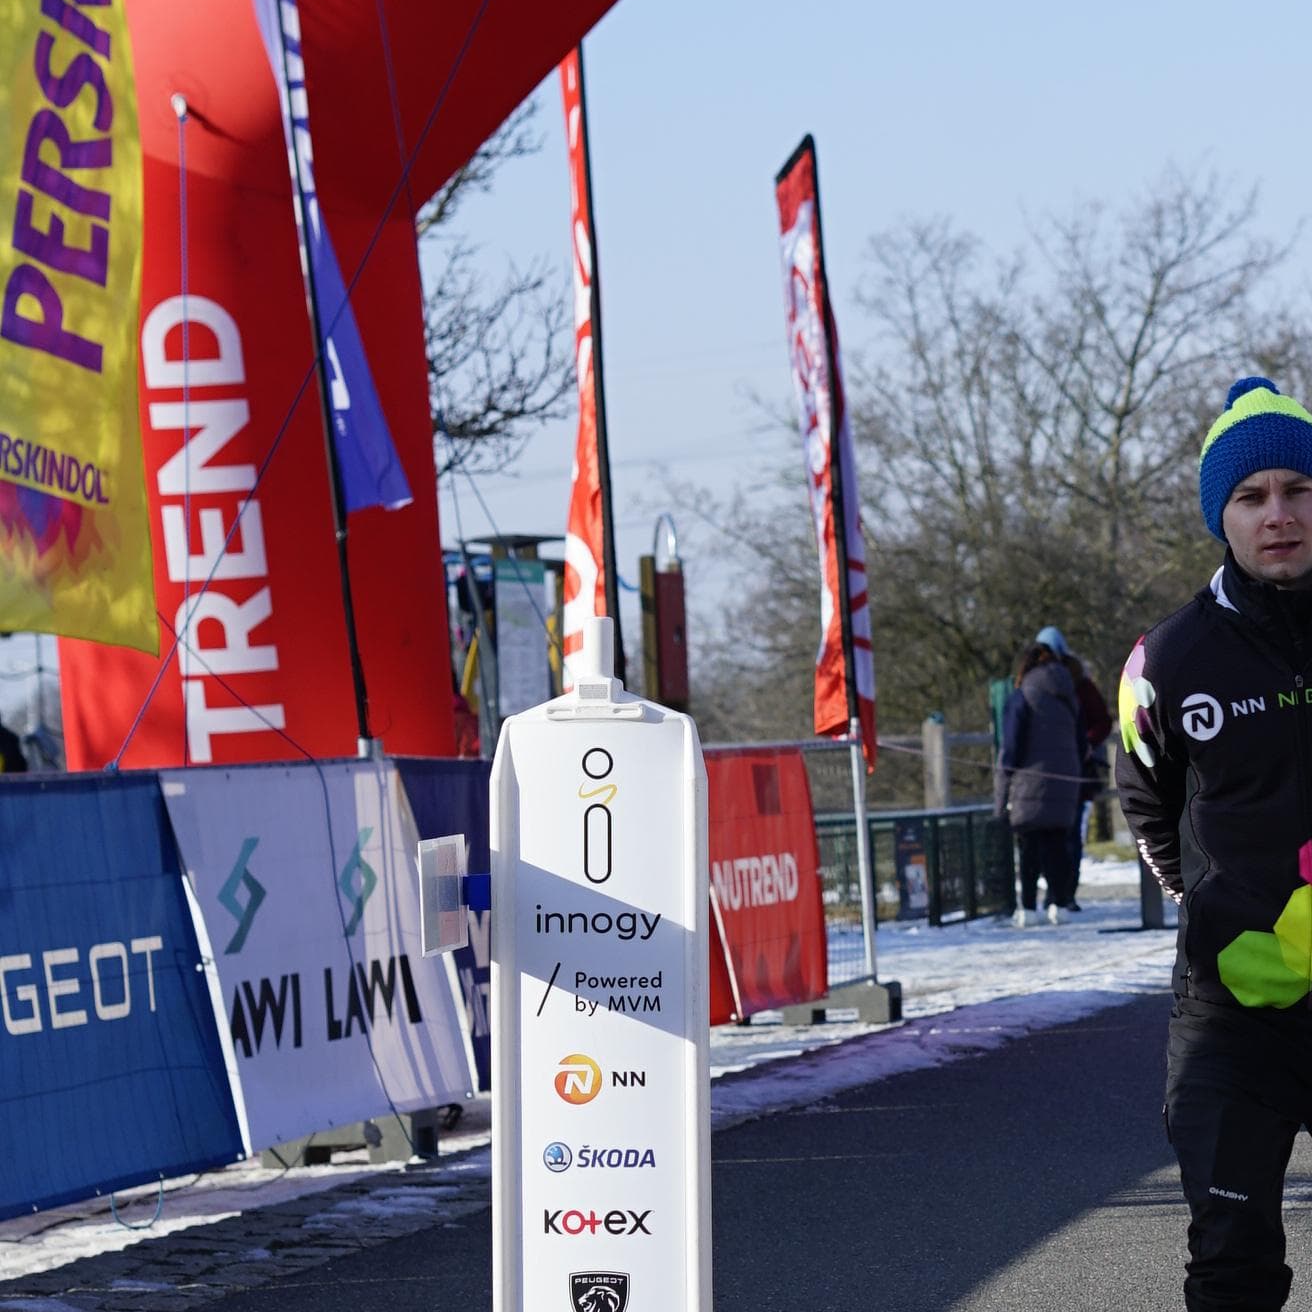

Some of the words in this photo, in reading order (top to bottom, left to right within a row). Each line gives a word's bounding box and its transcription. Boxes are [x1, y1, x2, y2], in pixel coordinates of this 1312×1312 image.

[1230, 696, 1266, 717] NN
[712, 851, 799, 911] NUTREND
[536, 904, 661, 940] innogy
[575, 971, 662, 989] Powered
[324, 954, 422, 1042] LAWI
[575, 994, 598, 1016] by
[608, 995, 661, 1012] MVM
[612, 1071, 646, 1087] NN
[577, 1145, 656, 1168] ŠKODA
[574, 1276, 624, 1285] PEUGEOT
